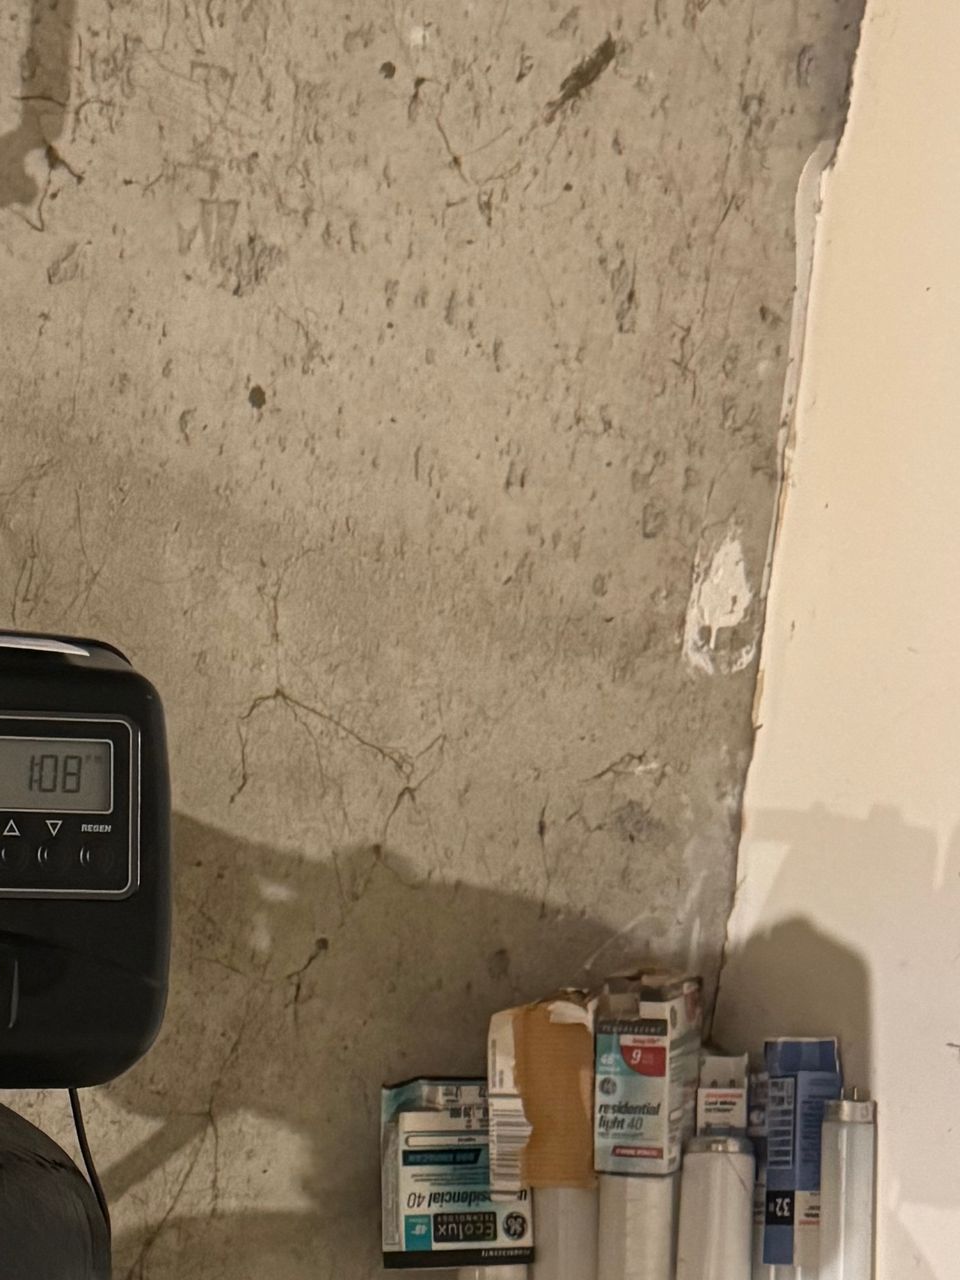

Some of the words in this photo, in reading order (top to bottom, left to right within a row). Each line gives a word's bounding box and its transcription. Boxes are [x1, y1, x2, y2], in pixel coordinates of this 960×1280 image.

[28, 754, 82, 793] 1:08
[81, 824, 112, 833] REGEN
[630, 1048, 642, 1065] 9
[598, 1101, 661, 1116] residential
[598, 1115, 625, 1131] light
[627, 1117, 644, 1130] 40
[407, 1192, 426, 1209] 40
[775, 1197, 791, 1216] 32
[438, 1223, 495, 1239] Ecolux
